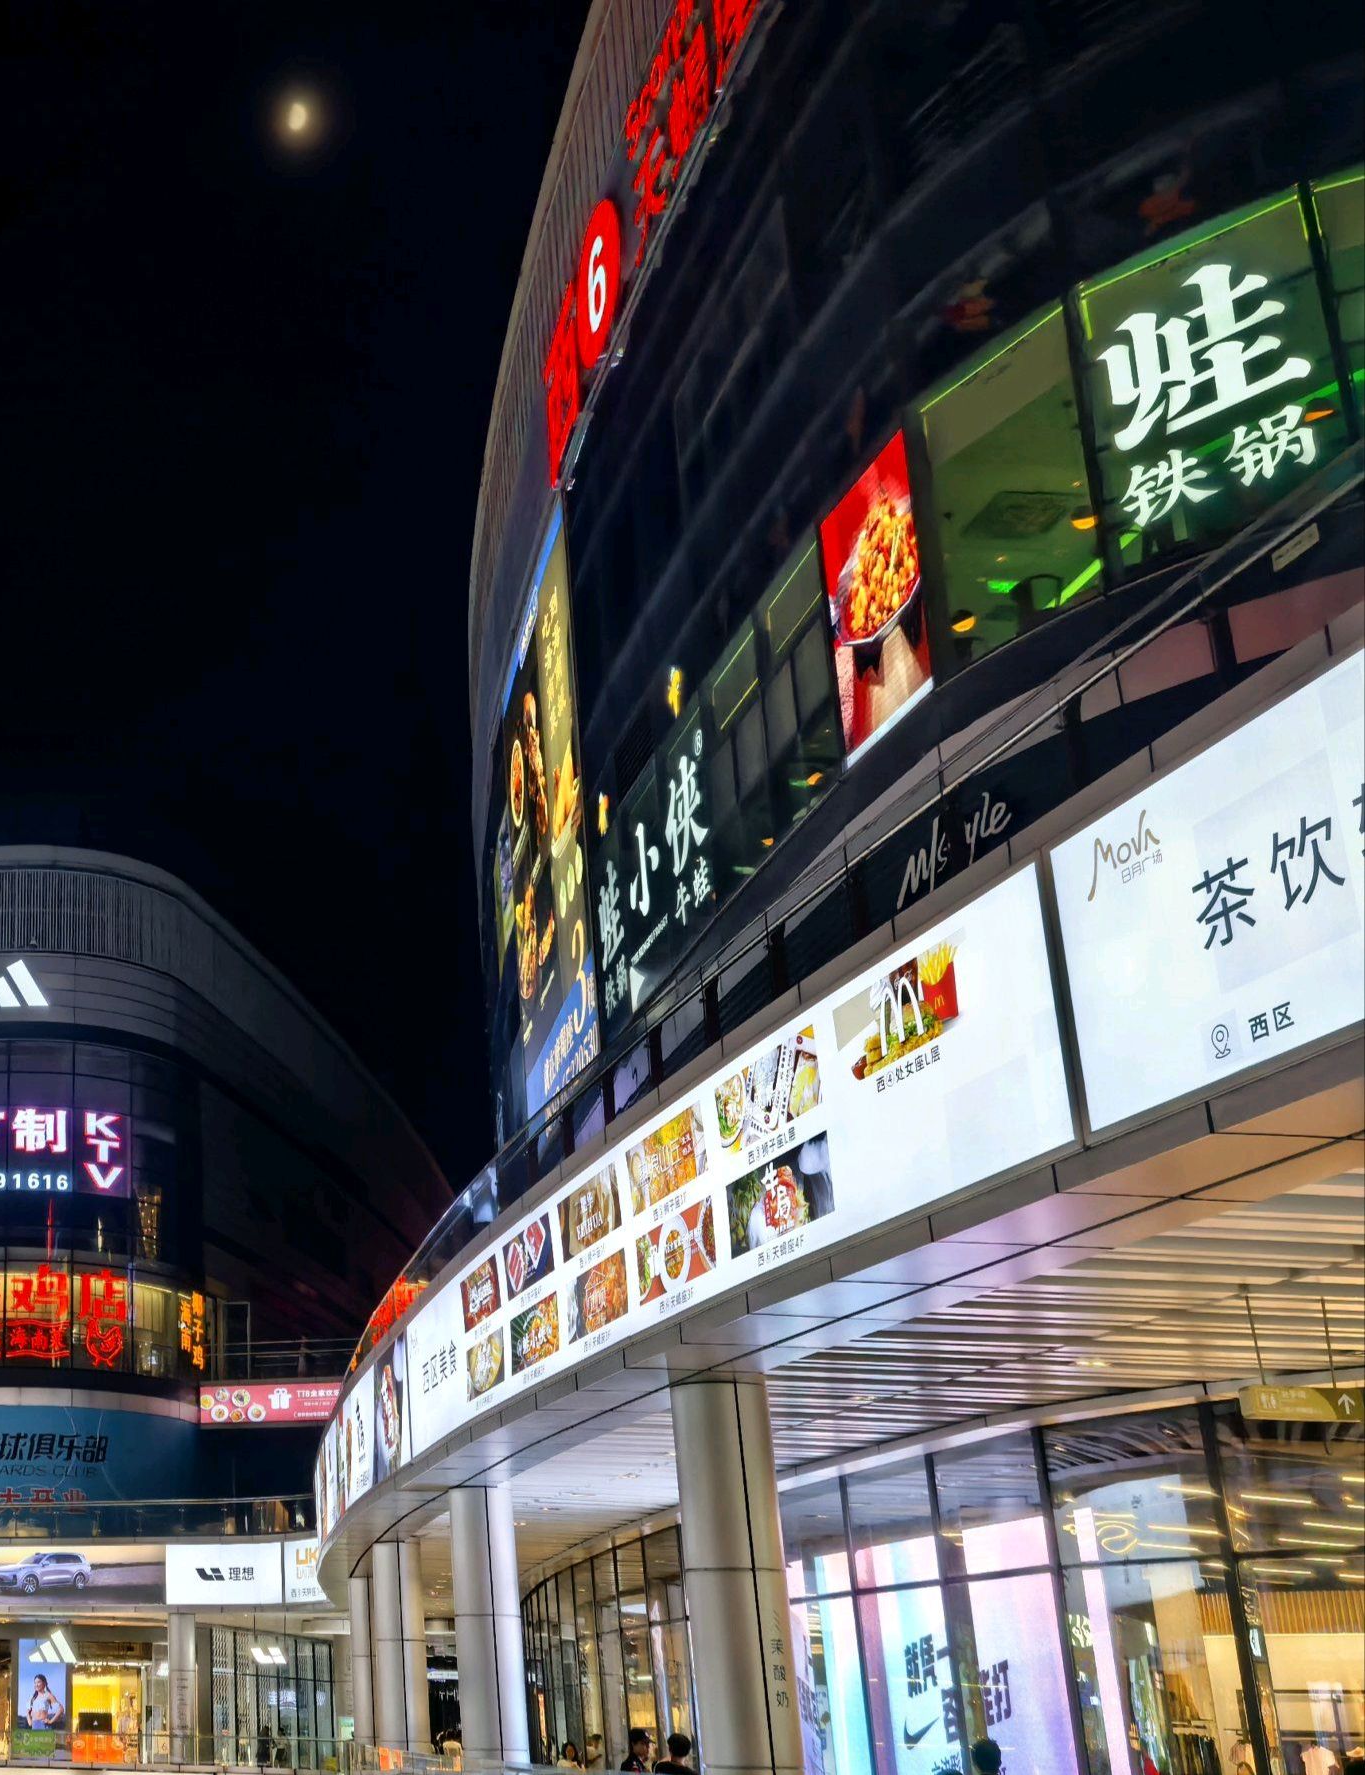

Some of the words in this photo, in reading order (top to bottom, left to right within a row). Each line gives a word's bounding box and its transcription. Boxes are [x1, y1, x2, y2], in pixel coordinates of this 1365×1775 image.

[1098, 264, 1312, 451] 蛙
[1120, 405, 1317, 527] 铁锅
[598, 755, 708, 972] 蛙小侠
[1121, 850, 1164, 885] 日月广场
[1248, 1002, 1295, 1043] 西区
[83, 1112, 124, 1190] KTV
[53, 1464, 98, 1479] CLUB
[228, 1567, 255, 1581] 理想
[770, 1638, 790, 1709] 茉酸奶
